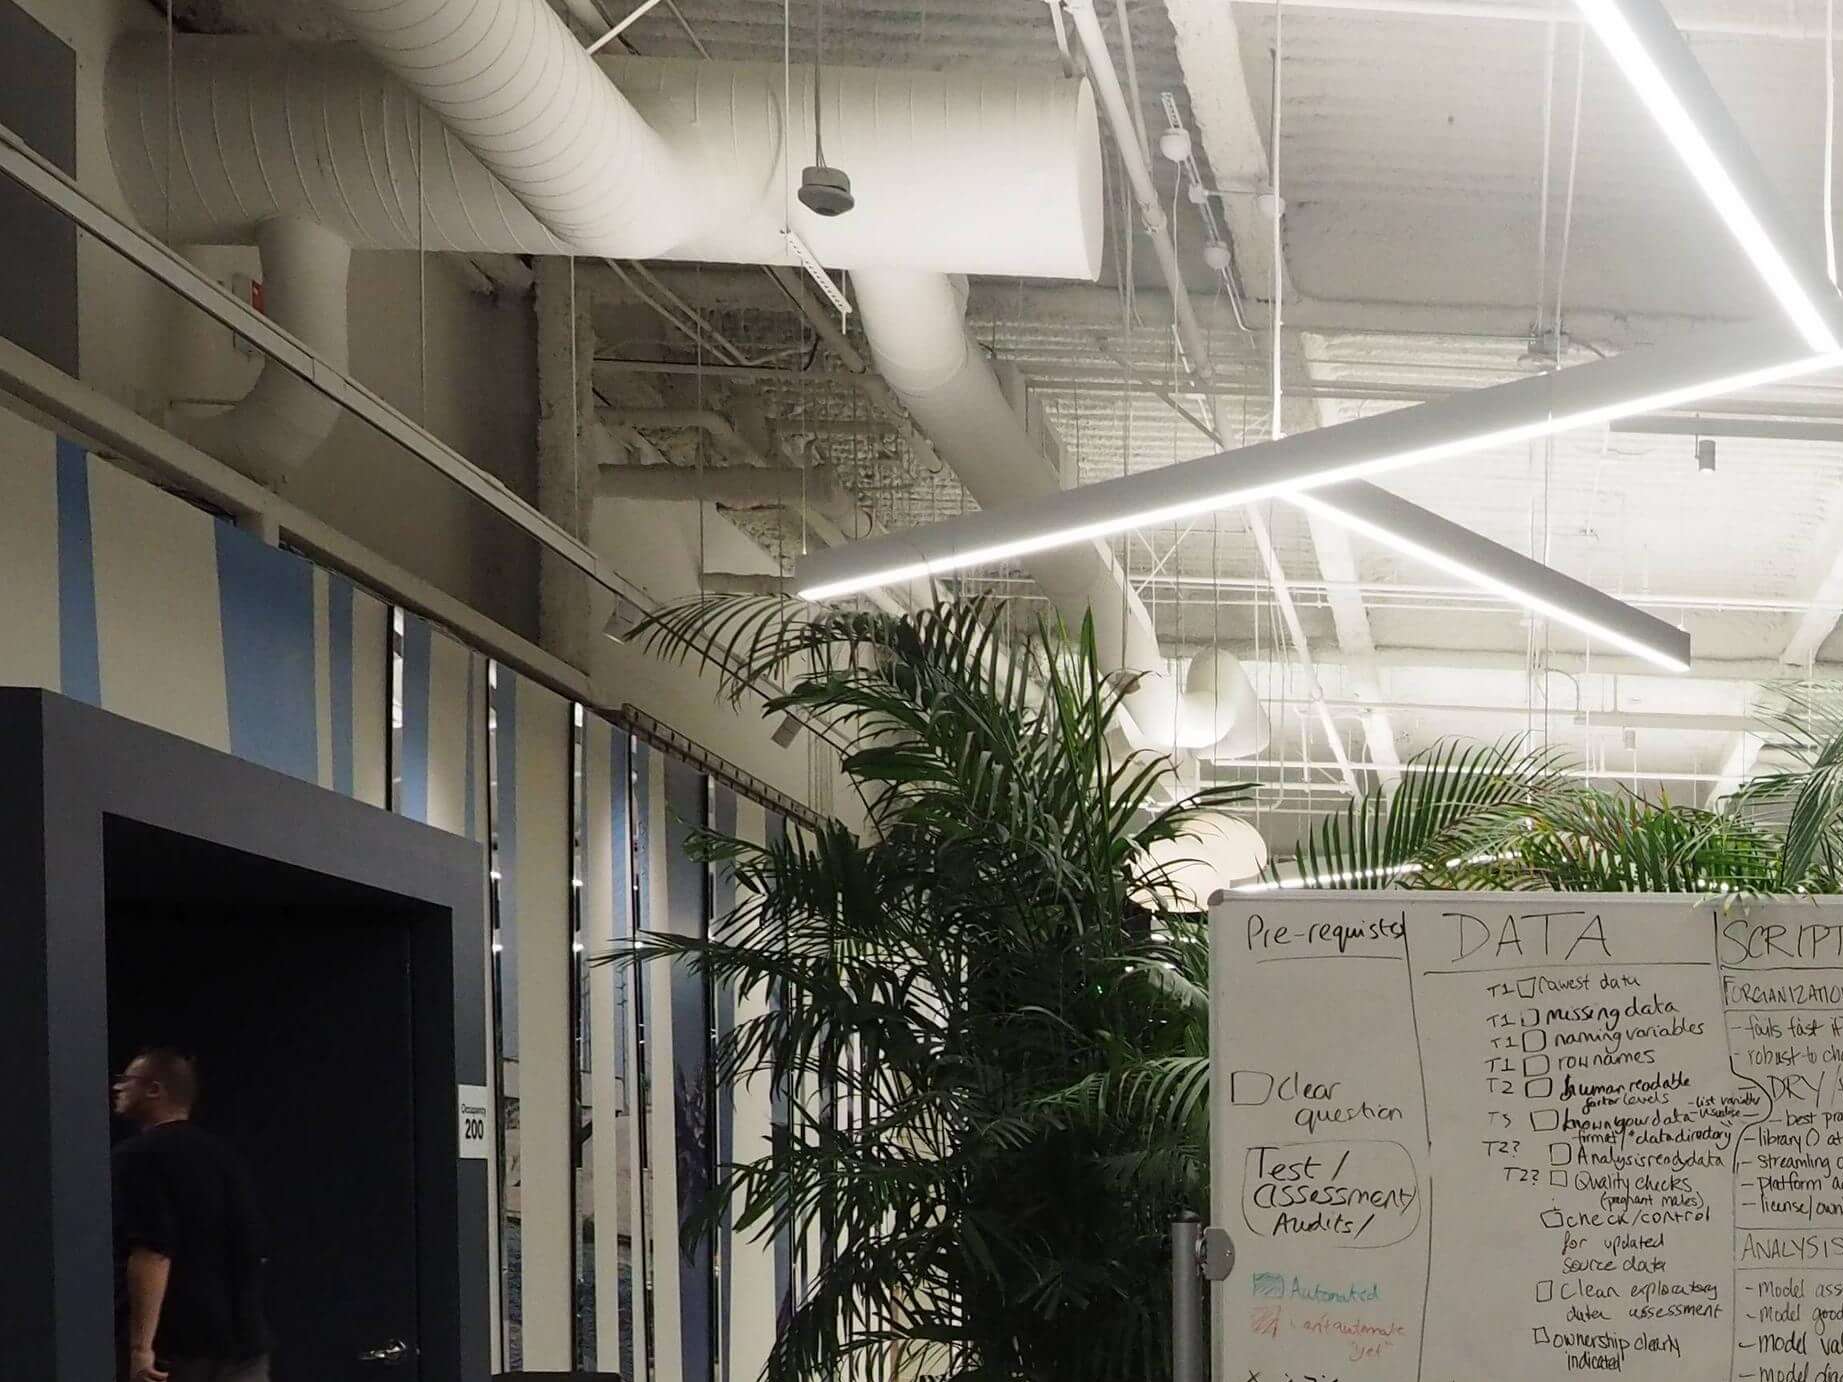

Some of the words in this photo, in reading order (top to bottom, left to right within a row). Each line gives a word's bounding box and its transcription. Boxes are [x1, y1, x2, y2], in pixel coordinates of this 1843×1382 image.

[1442, 911, 1612, 962] DATA
[1547, 1005, 1620, 1032] missing
[1625, 993, 1679, 1017] data
[1555, 1028, 1620, 1054] naming
[1626, 1019, 1705, 1041] variables
[1747, 1042, 1803, 1065] robust
[1486, 1077, 1513, 1094] T2
[1629, 1071, 1690, 1092] readable
[1295, 1101, 1402, 1135] question
[1653, 1107, 1695, 1124] data
[1786, 1109, 1816, 1127] best
[465, 1118, 484, 1140] 200
[1827, 1130, 1843, 1146] at
[1575, 1171, 1629, 1200] Quality
[1635, 1172, 1693, 1192] checks
[1757, 1172, 1823, 1197] platform
[1604, 1233, 1665, 1256] updated
[1561, 1258, 1616, 1275] source
[1552, 1331, 1630, 1360] ownership
